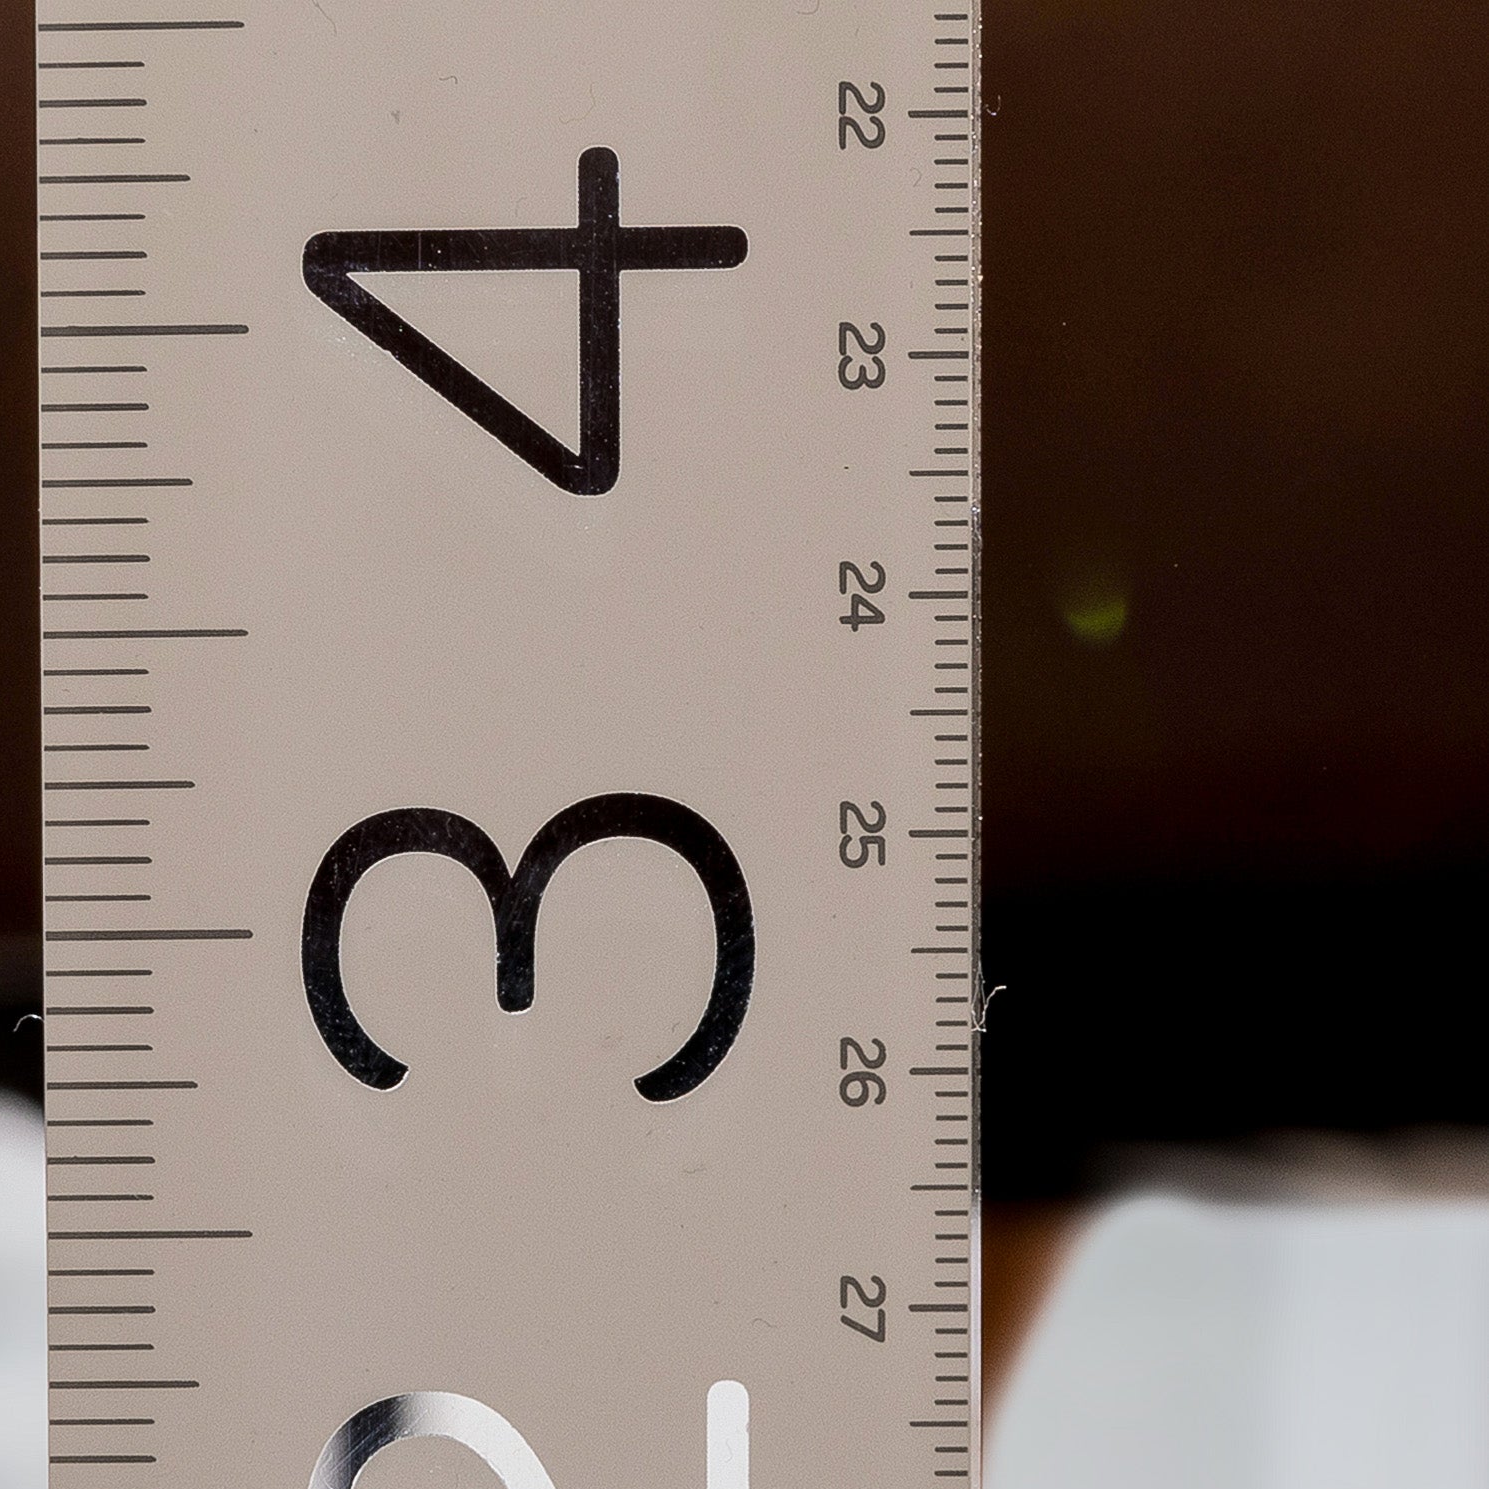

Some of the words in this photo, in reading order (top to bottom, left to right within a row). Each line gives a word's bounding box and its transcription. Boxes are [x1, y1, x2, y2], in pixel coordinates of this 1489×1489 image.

[838, 81, 885, 150] 22
[302, 145, 749, 497] 4
[838, 322, 886, 390] 23
[839, 561, 886, 632] 24
[839, 801, 886, 869] 25
[301, 791, 756, 1103] 3
[839, 1037, 886, 1107] 26
[839, 1275, 886, 1343] 27
